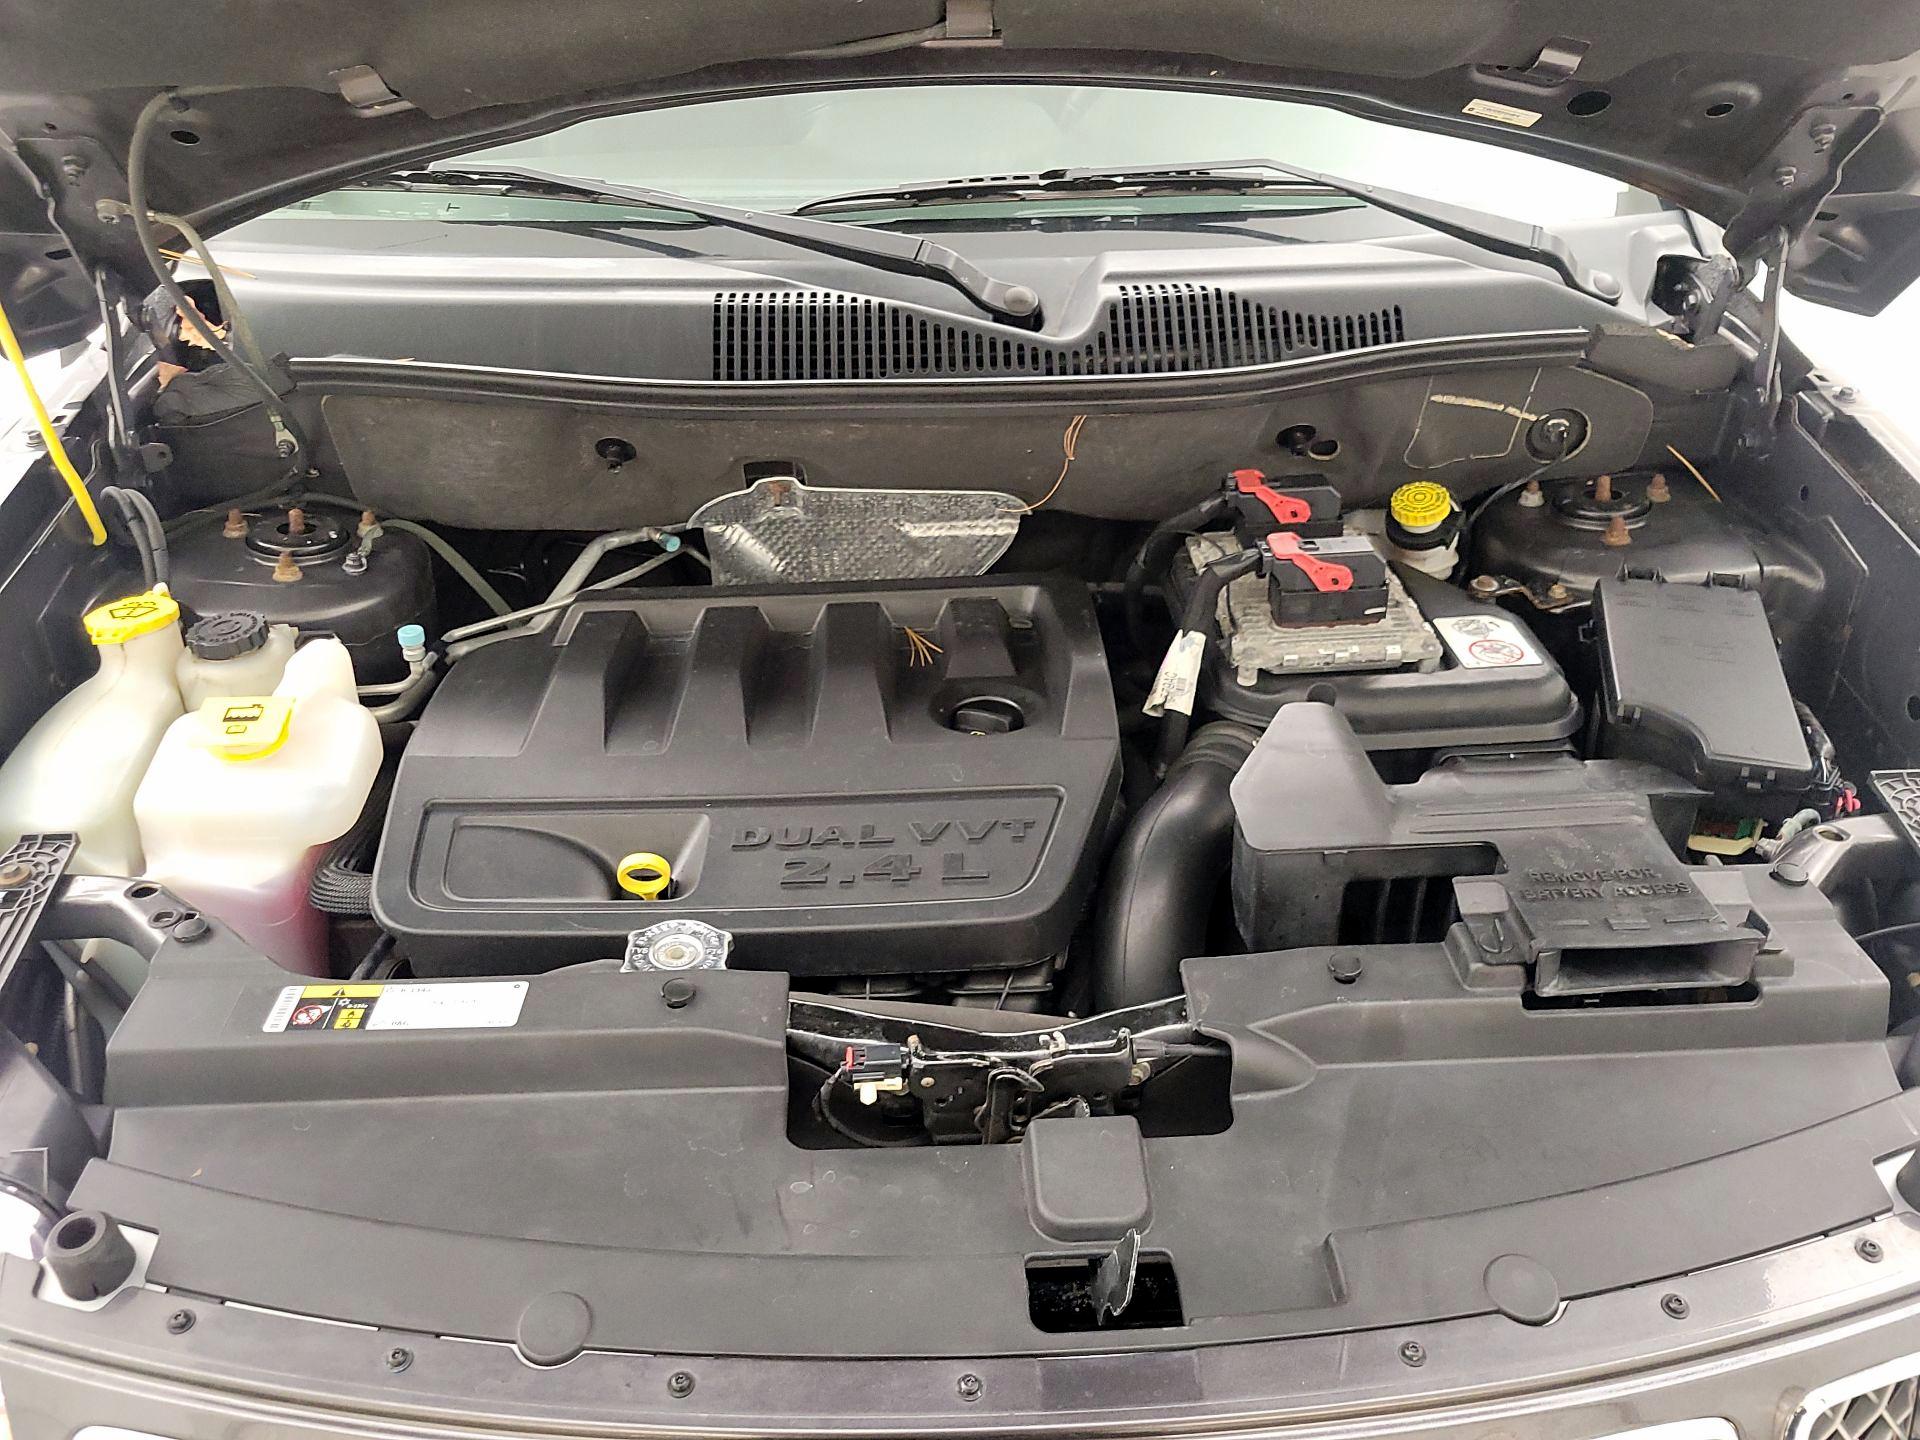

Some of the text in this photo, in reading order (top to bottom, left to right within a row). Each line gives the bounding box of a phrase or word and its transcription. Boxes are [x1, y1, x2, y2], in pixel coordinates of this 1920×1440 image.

[731, 817, 1036, 849] DUAL VVT
[1528, 866, 1661, 884] REMOVE FOR
[1520, 881, 1692, 901] BATTERY ACCESS
